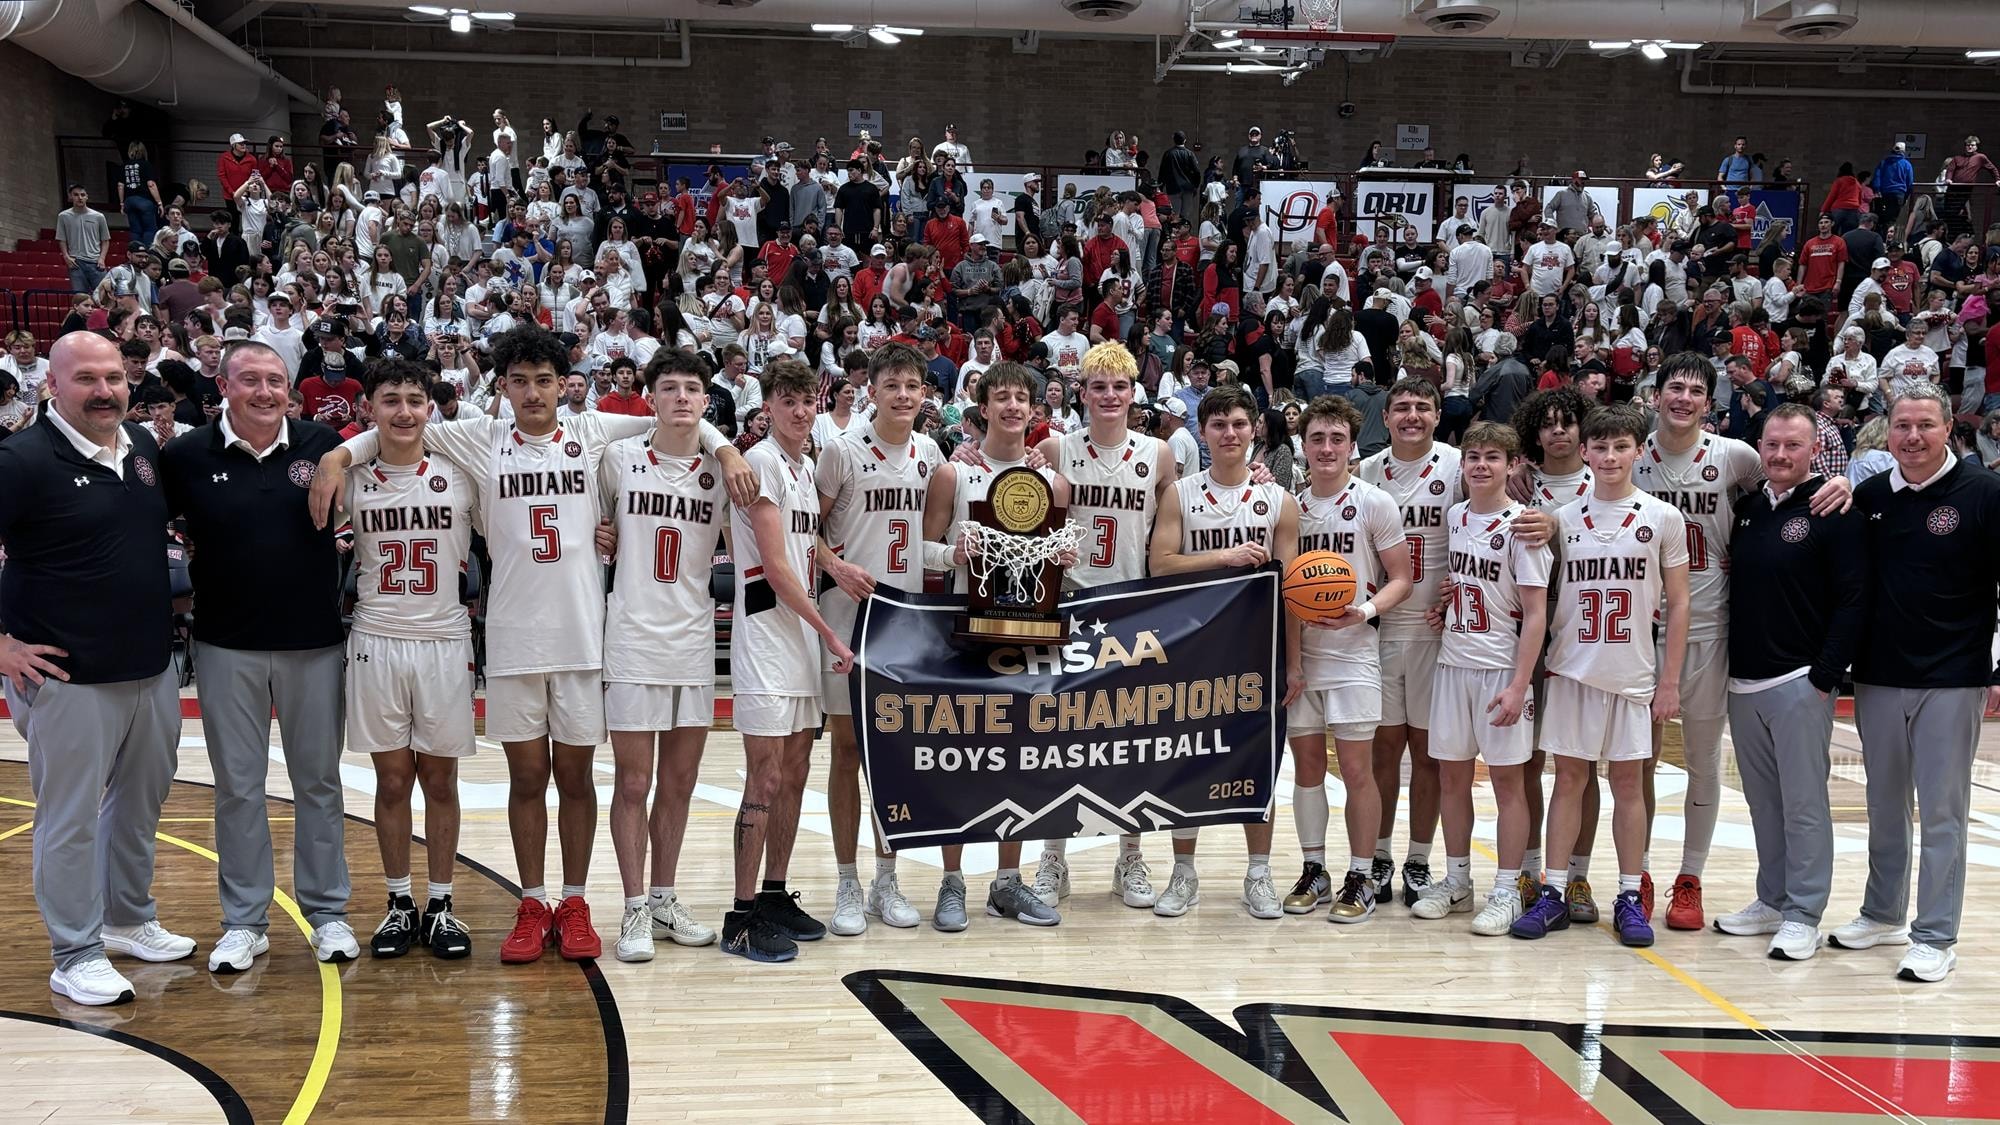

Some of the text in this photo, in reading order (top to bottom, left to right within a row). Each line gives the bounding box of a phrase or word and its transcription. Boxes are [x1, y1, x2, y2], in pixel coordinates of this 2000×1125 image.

[500, 469, 585, 499] INDIANS
[864, 487, 926, 513] INDIAN
[1070, 484, 1146, 511] INDIANS
[360, 505, 452, 533] INDIANS
[628, 490, 713, 524] INDIANS
[529, 504, 561, 563] 5
[887, 519, 909, 573] 2
[1090, 515, 1118, 568] 3
[1191, 527, 1267, 552] INDIANS
[378, 538, 438, 595] 25
[654, 525, 682, 583] 0
[1567, 556, 1647, 583] INDIANS
[1301, 563, 1351, 580] Wilson
[1314, 591, 1344, 602] EVO
[1451, 582, 1490, 633] 13
[1007, 611, 1045, 619] CHAMPION
[1578, 588, 1632, 643] 32
[988, 630, 1168, 676] CHSAA
[875, 672, 1264, 735] STATE CHAMPIONS
[914, 729, 1231, 772] BOYS BASKETBALL
[1209, 778, 1256, 800] 2026
[887, 803, 912, 823] 3A
